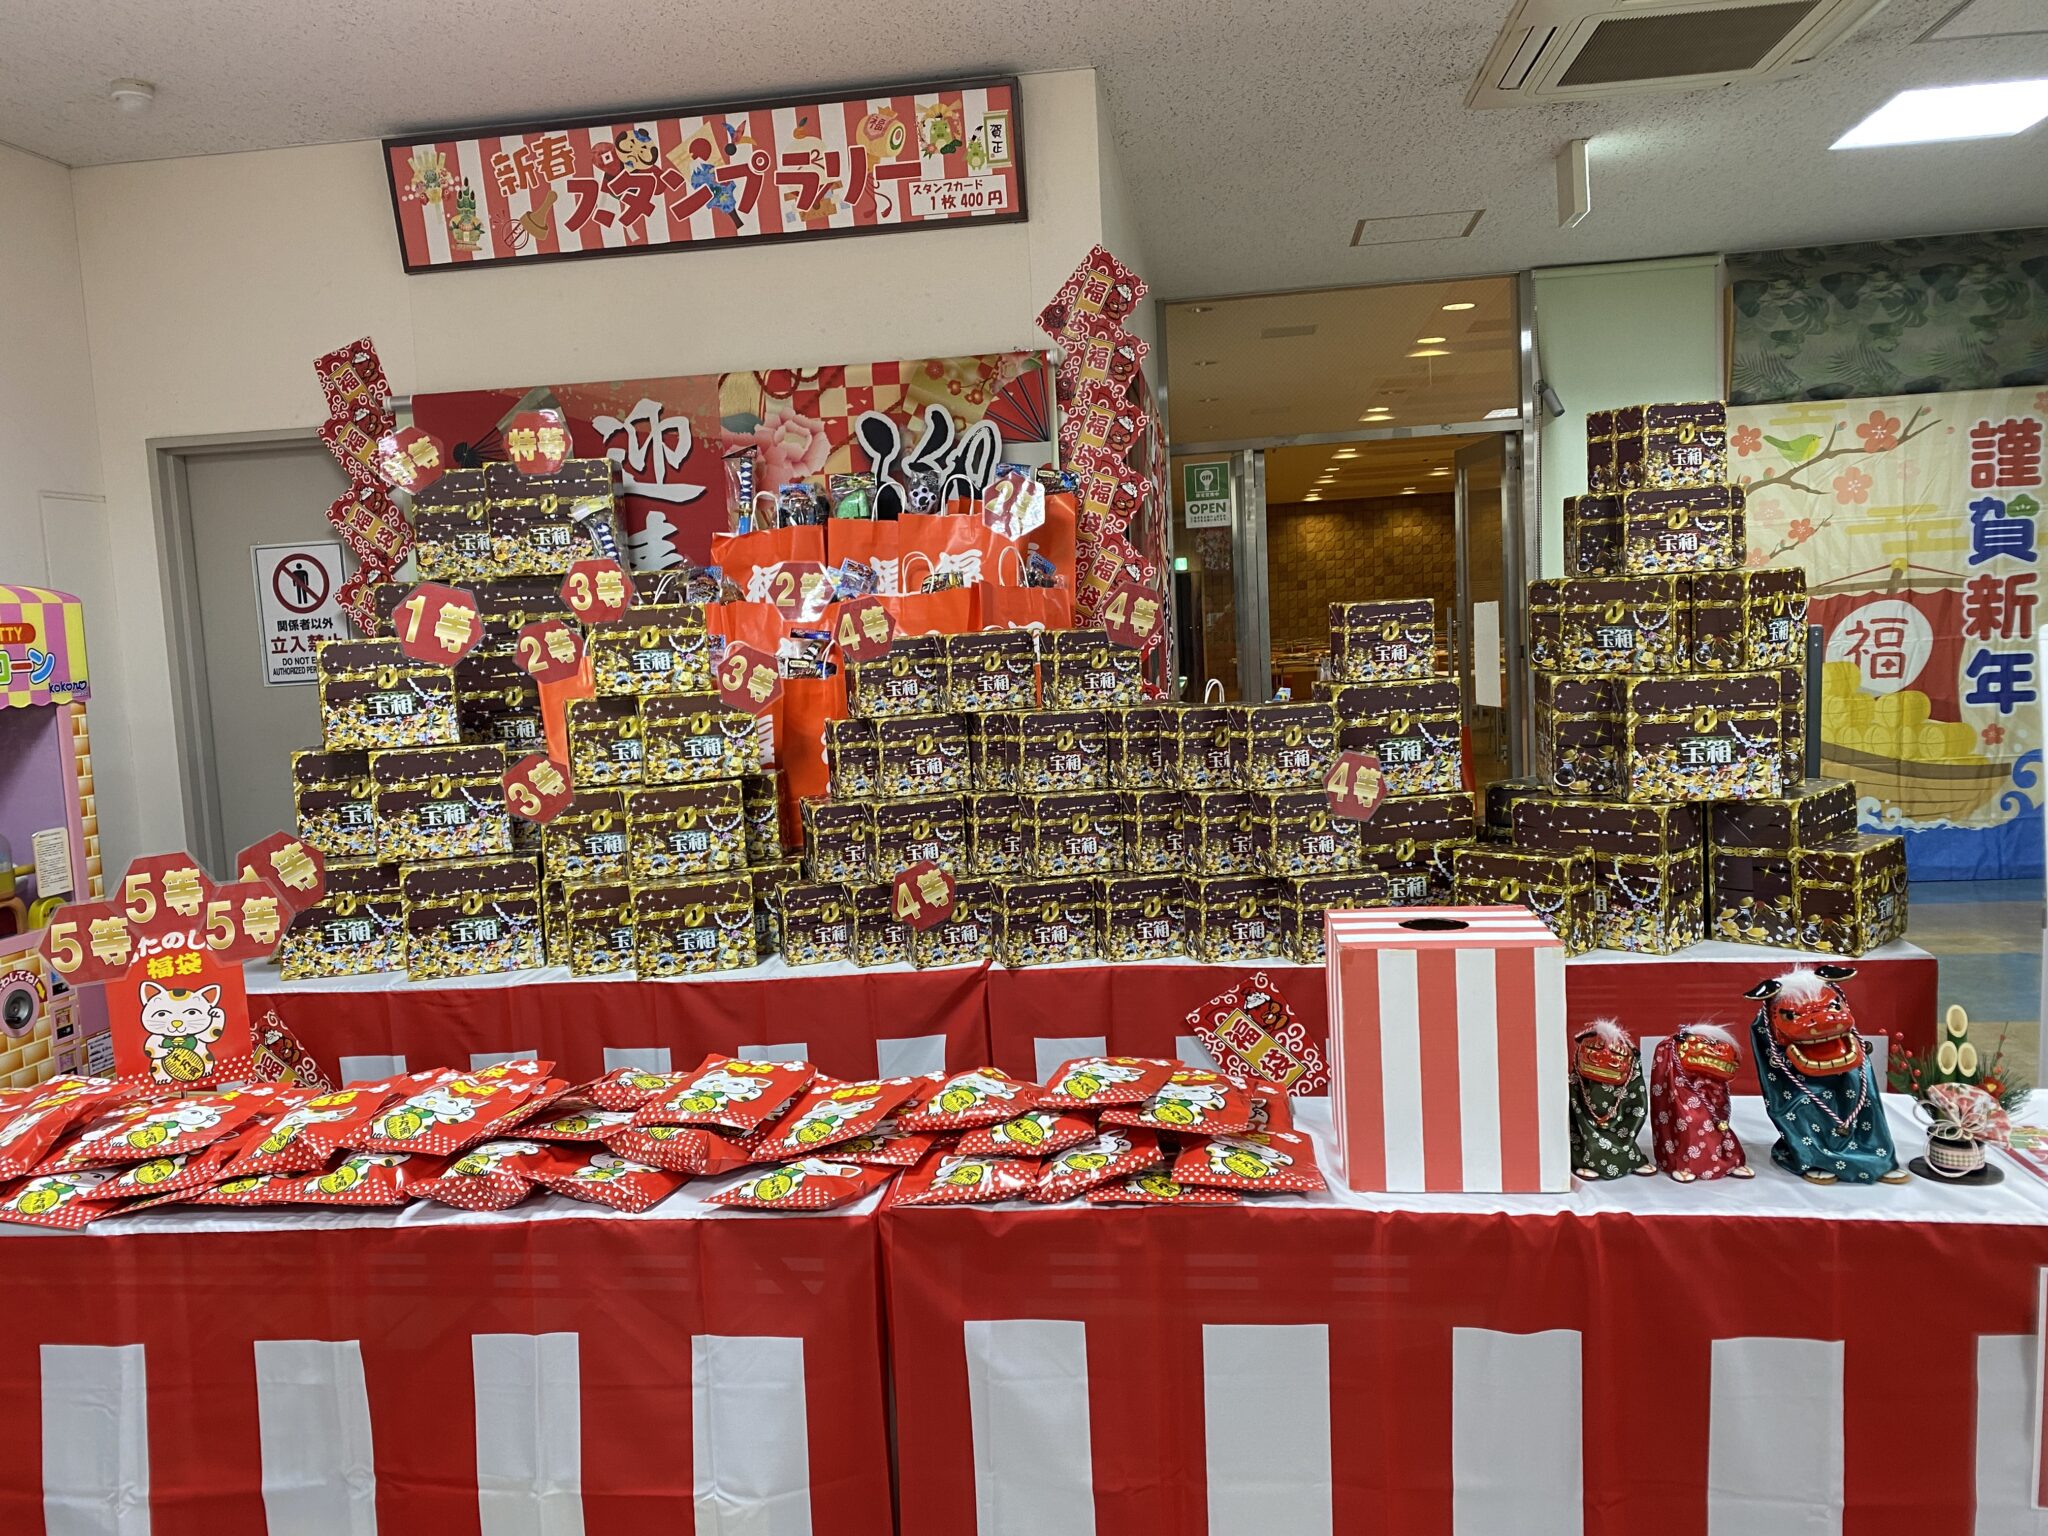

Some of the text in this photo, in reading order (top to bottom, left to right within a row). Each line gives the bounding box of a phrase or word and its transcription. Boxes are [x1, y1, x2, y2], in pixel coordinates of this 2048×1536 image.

[868, 116, 885, 132] 福
[989, 124, 1003, 155] 賀正
[491, 136, 575, 196] 新春
[564, 145, 921, 233] スタンプラリー
[913, 179, 983, 195] スタンプカード
[509, 427, 566, 462] 特等
[1672, 448, 1702, 466] 宝箱
[1077, 478, 1116, 538] 福袋
[1189, 502, 1227, 514] OPEN
[351, 508, 399, 551] 福袋
[532, 527, 571, 546] 宝箱
[1659, 533, 1698, 553] 宝箱
[1964, 417, 2044, 716] 謹賀新年
[569, 569, 625, 612] 3等
[1077, 554, 1118, 613] 福袋
[277, 617, 334, 632] 関係者以外
[405, 594, 476, 653] 1等
[1105, 592, 1160, 638] 4等
[838, 605, 890, 651] 4等
[1769, 622, 1789, 642] 宝箱
[1597, 629, 1634, 649] 宝箱
[1844, 617, 1909, 681] 福
[283, 658, 293, 666] DO
[295, 657, 309, 665] NOT
[520, 628, 577, 674] 2等
[1375, 644, 1407, 663] 宝箱
[273, 667, 305, 676] AUTHORIZED
[633, 652, 671, 672] 宝箱
[722, 655, 779, 704] 3等
[886, 679, 918, 697] 宝箱
[977, 674, 1011, 692] 宝箱
[1085, 671, 1116, 691] 宝箱
[368, 696, 414, 717] 宝箱
[496, 720, 537, 739] 宝箱
[684, 738, 722, 757] 宝箱
[1380, 740, 1422, 763] 宝箱
[1681, 741, 1733, 764] 宝箱
[910, 757, 943, 776] 宝箱
[1050, 754, 1082, 774] 宝箱
[1278, 749, 1310, 769] 宝箱
[508, 760, 567, 816] 3等
[1327, 762, 1381, 808] 4等
[419, 804, 468, 827] 宝箱
[585, 835, 625, 856] 宝箱
[670, 832, 710, 853] 宝箱
[845, 843, 866, 862] 宝
[905, 843, 938, 862] 宝箱
[1005, 836, 1020, 853] 宝
[1066, 836, 1097, 855] 宝箱
[1167, 833, 1183, 852] 宝
[1303, 835, 1335, 855] 宝箱
[125, 867, 204, 924] 5等
[897, 868, 950, 921] 4等
[1390, 876, 1427, 899] 宝箱
[206, 897, 281, 950] 5等
[325, 921, 372, 945] 宝箱
[452, 920, 499, 945] 宝箱
[1137, 919, 1170, 941] 宝箱
[1232, 919, 1265, 940] 宝箱
[51, 916, 132, 974] 5等
[611, 929, 635, 950] 宝
[677, 931, 716, 951] 宝箱
[815, 925, 847, 945] 宝箱
[885, 926, 905, 945] 宝
[944, 925, 978, 945] 宝箱
[1034, 925, 1068, 945] 宝箱
[130, 929, 213, 967] たのし
[147, 951, 203, 979] 福袋
[1224, 1018, 1297, 1083] 福袋
